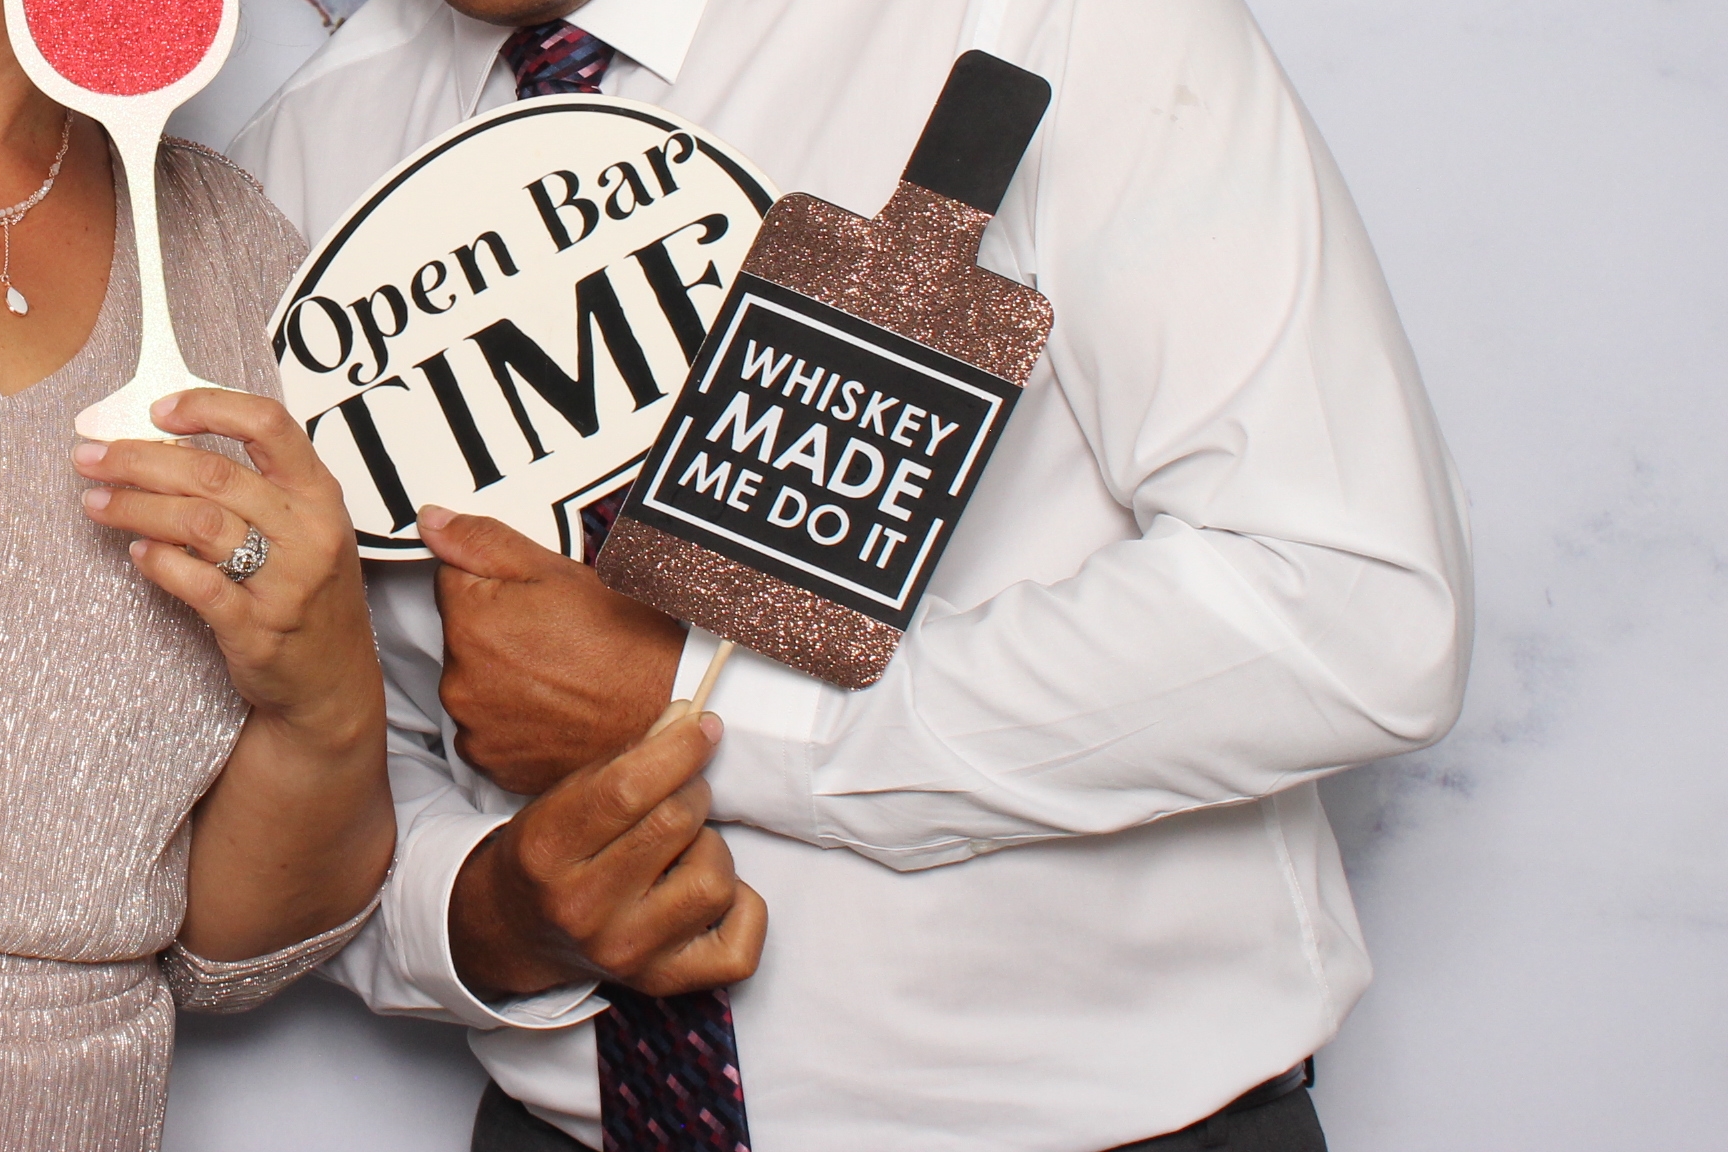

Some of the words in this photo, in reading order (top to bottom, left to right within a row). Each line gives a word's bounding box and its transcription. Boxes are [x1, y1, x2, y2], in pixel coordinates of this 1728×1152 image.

[286, 230, 521, 387] Open
[522, 131, 695, 254] Bar
[305, 212, 730, 535] TIME
[739, 338, 960, 457] WHISKEY
[677, 451, 764, 512] ME
[766, 484, 851, 546] DO
[858, 522, 908, 570] IT
[705, 390, 933, 522] MADE
